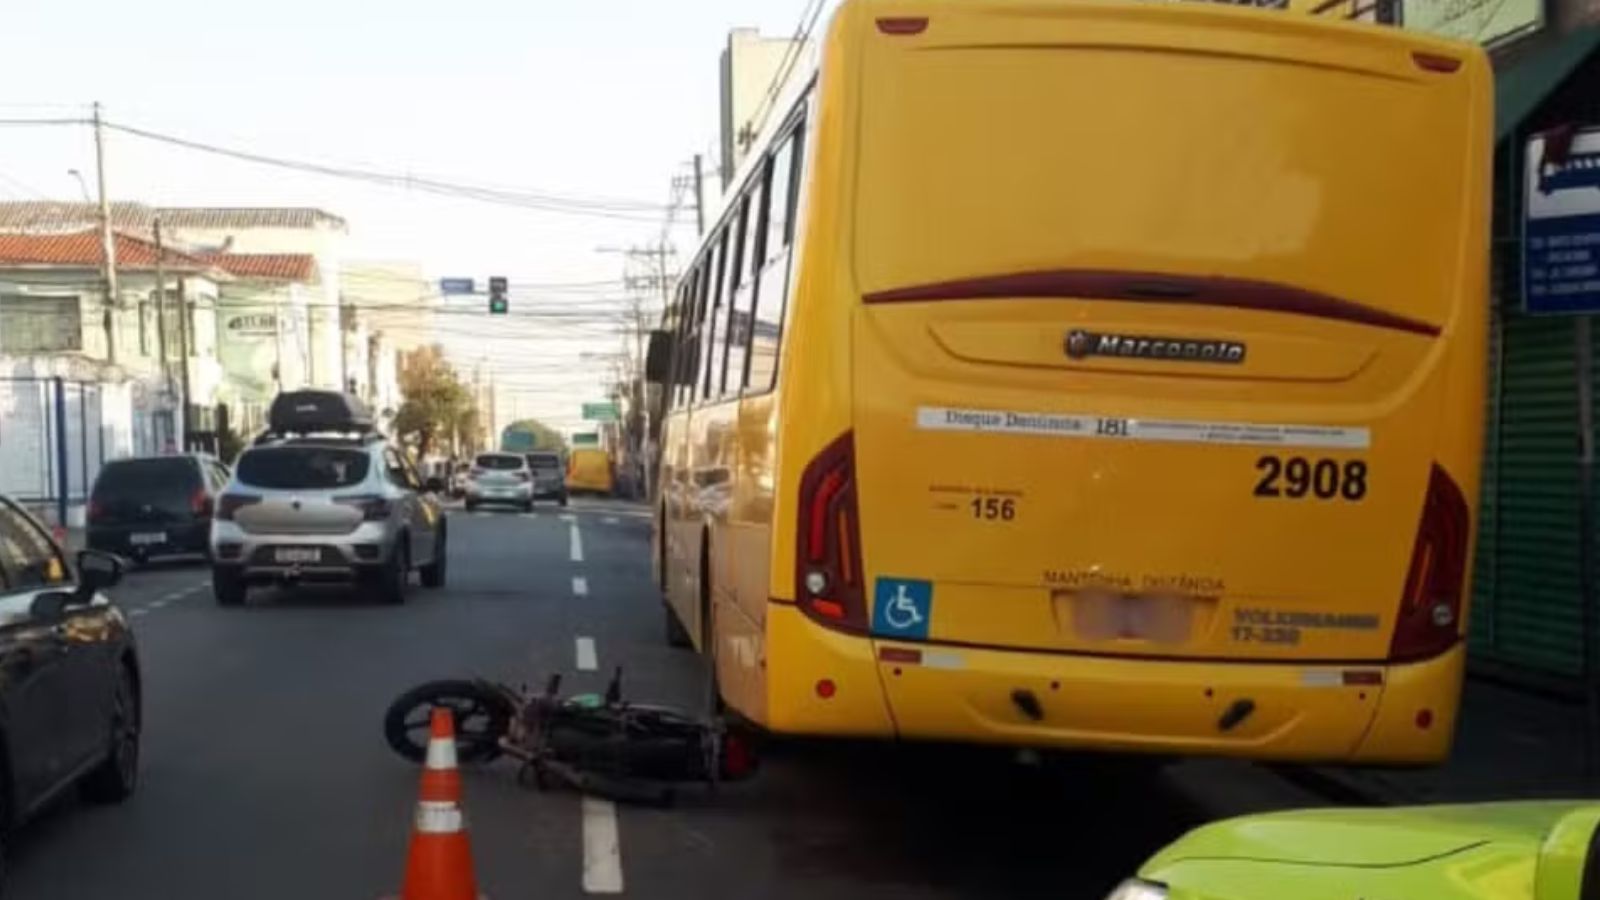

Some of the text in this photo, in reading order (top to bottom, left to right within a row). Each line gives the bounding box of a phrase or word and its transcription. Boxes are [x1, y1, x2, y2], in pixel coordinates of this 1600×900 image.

[1098, 336, 1243, 361] Marcopolo
[1097, 417, 1128, 437] 181
[1254, 457, 1368, 501] 2908
[972, 498, 1015, 520] 156
